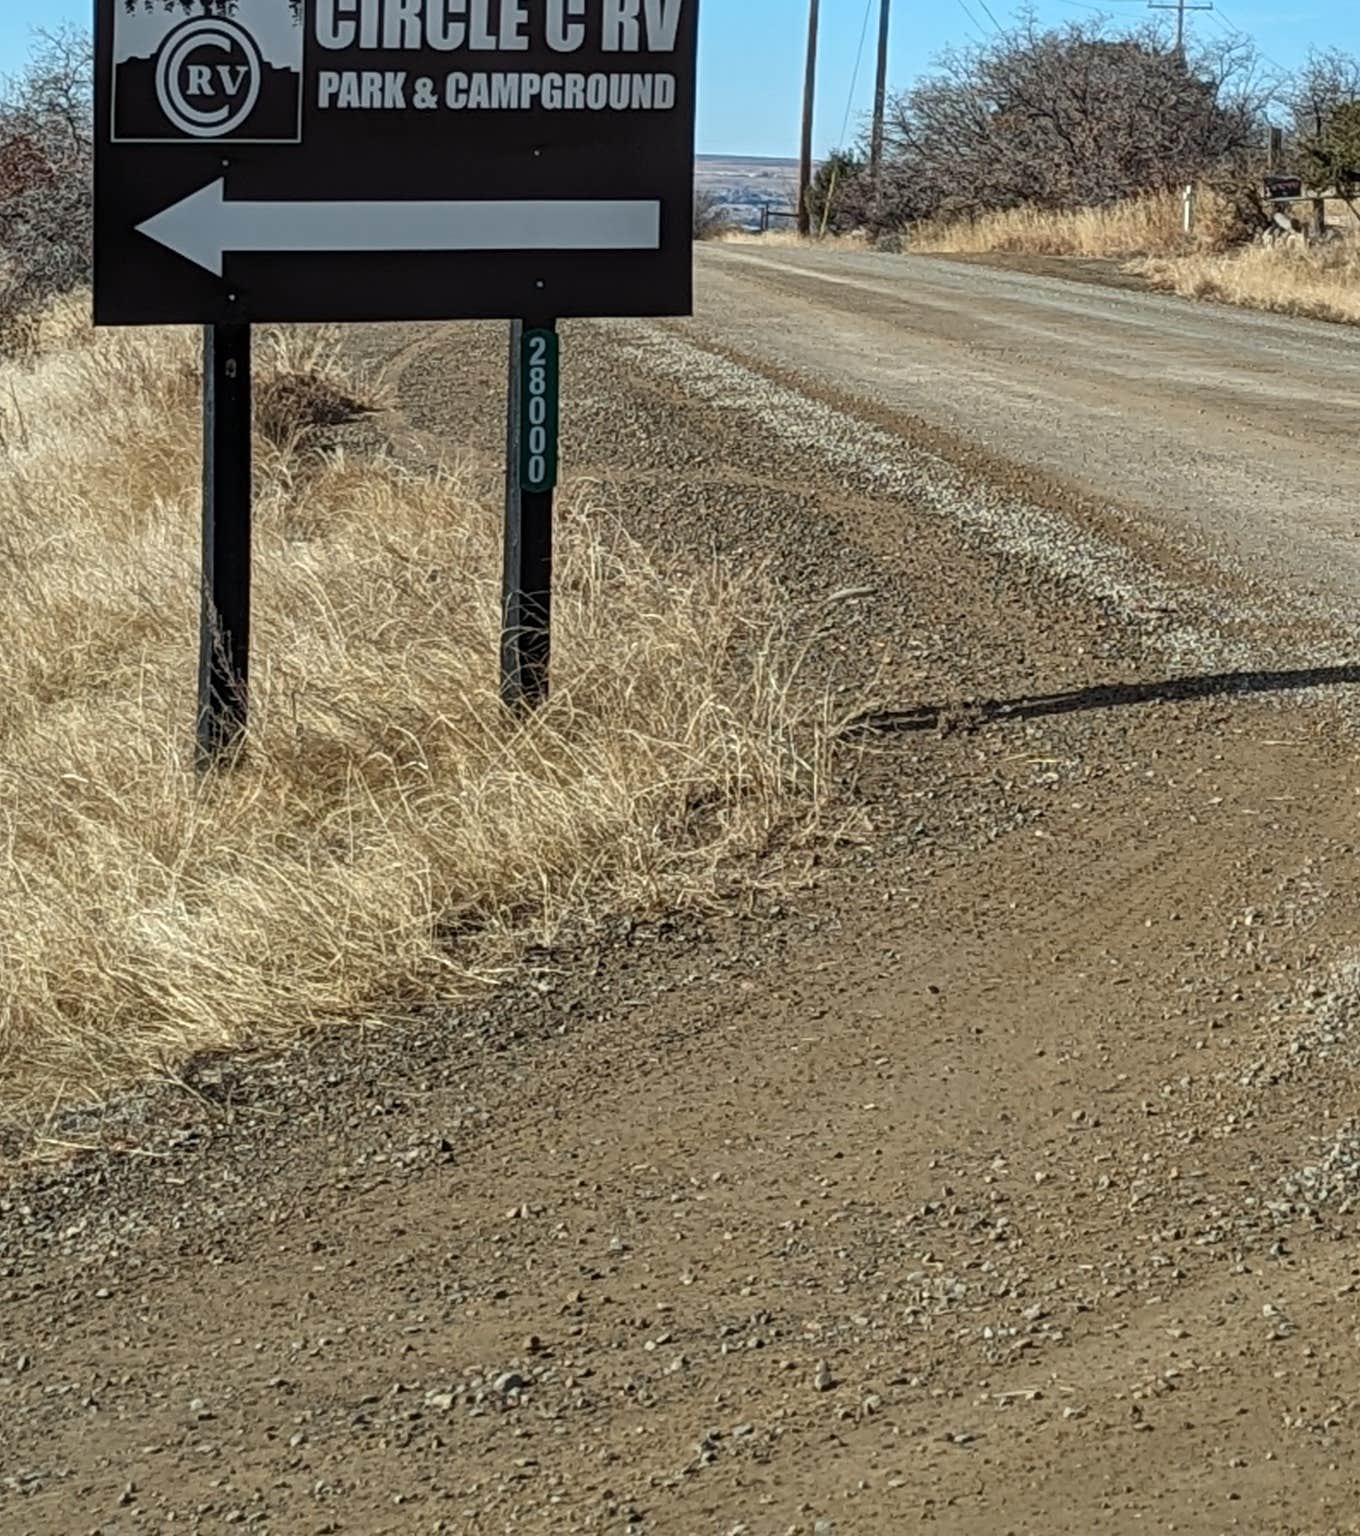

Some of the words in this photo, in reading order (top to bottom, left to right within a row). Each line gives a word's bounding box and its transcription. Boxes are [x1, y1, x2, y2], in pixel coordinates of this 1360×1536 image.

[186, 65, 248, 95] RV
[318, 72, 406, 109] PARK
[413, 78, 438, 109] &
[445, 72, 675, 110] CAMPGROUND
[528, 337, 547, 484] 28000
